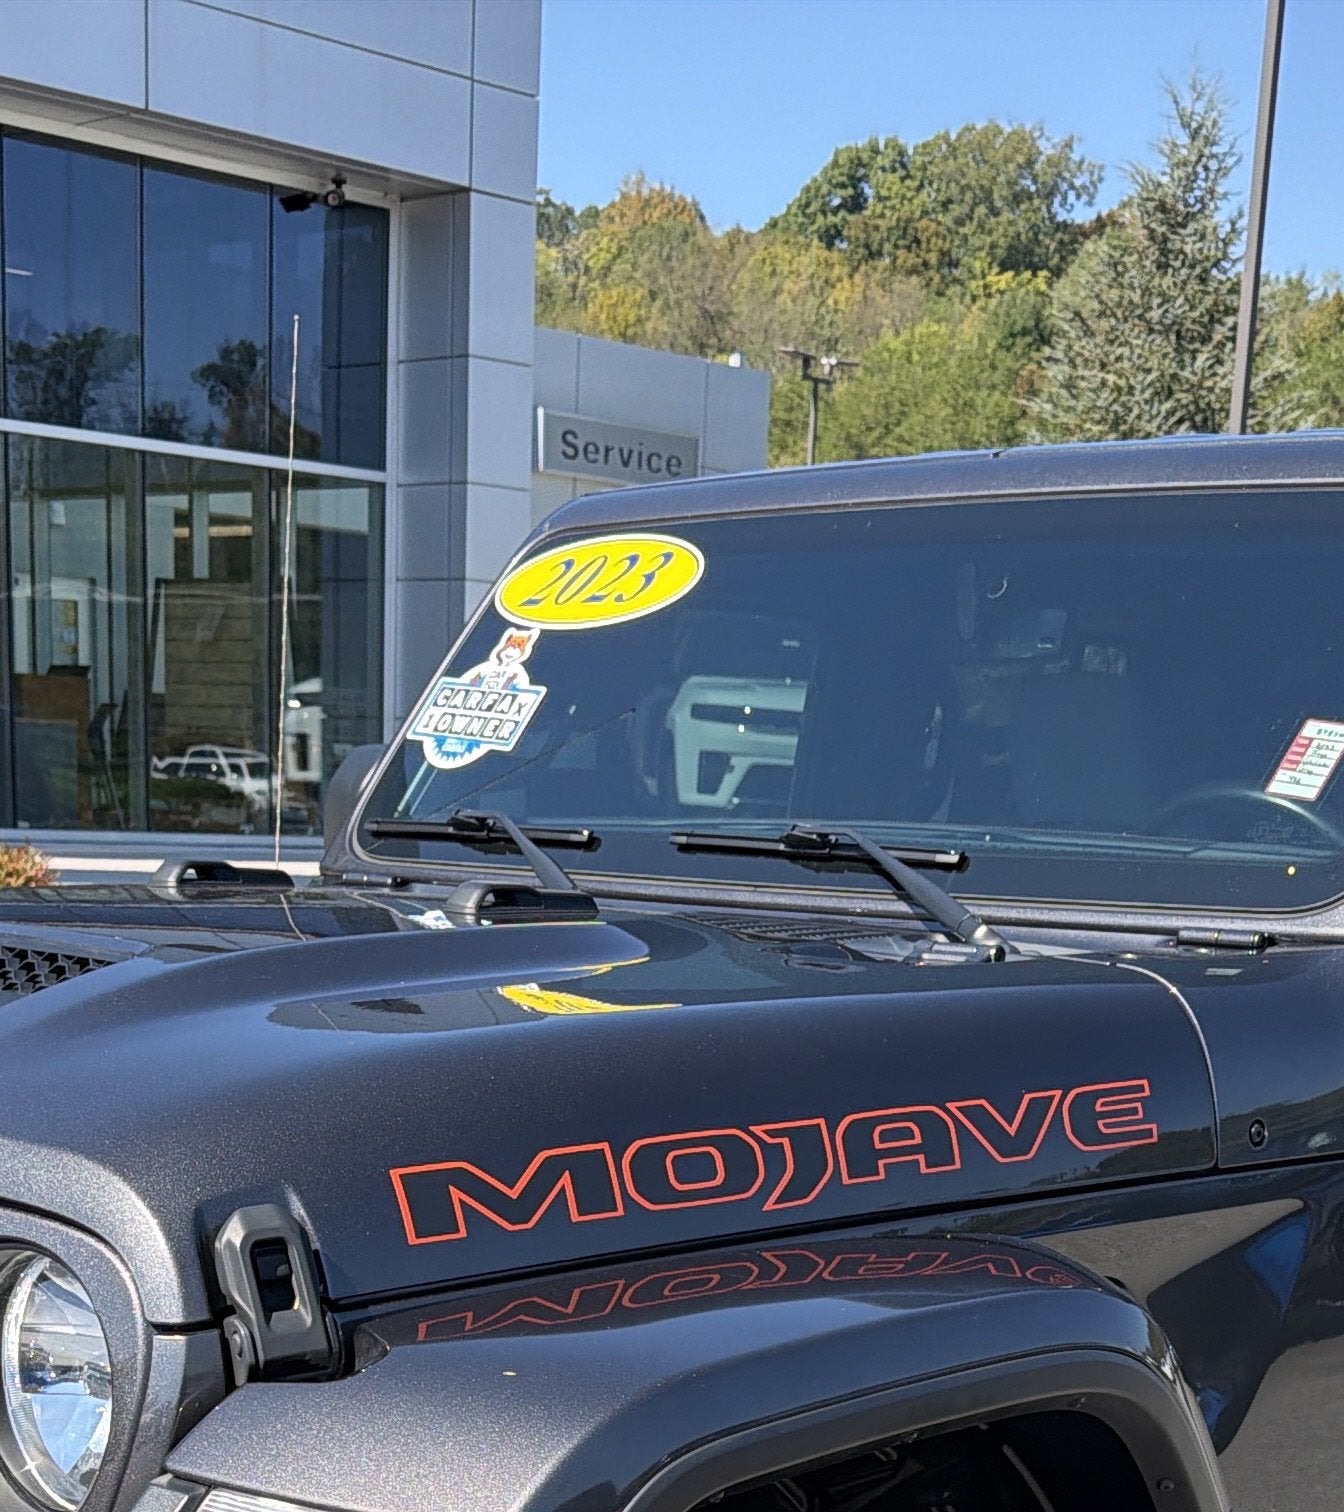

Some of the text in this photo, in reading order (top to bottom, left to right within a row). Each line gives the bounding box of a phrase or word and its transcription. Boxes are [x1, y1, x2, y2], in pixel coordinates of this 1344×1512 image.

[560, 428, 683, 478] Service
[517, 551, 675, 608] 2023
[433, 687, 529, 719] CARFAX
[389, 1078, 1159, 1246] MOJAVE
